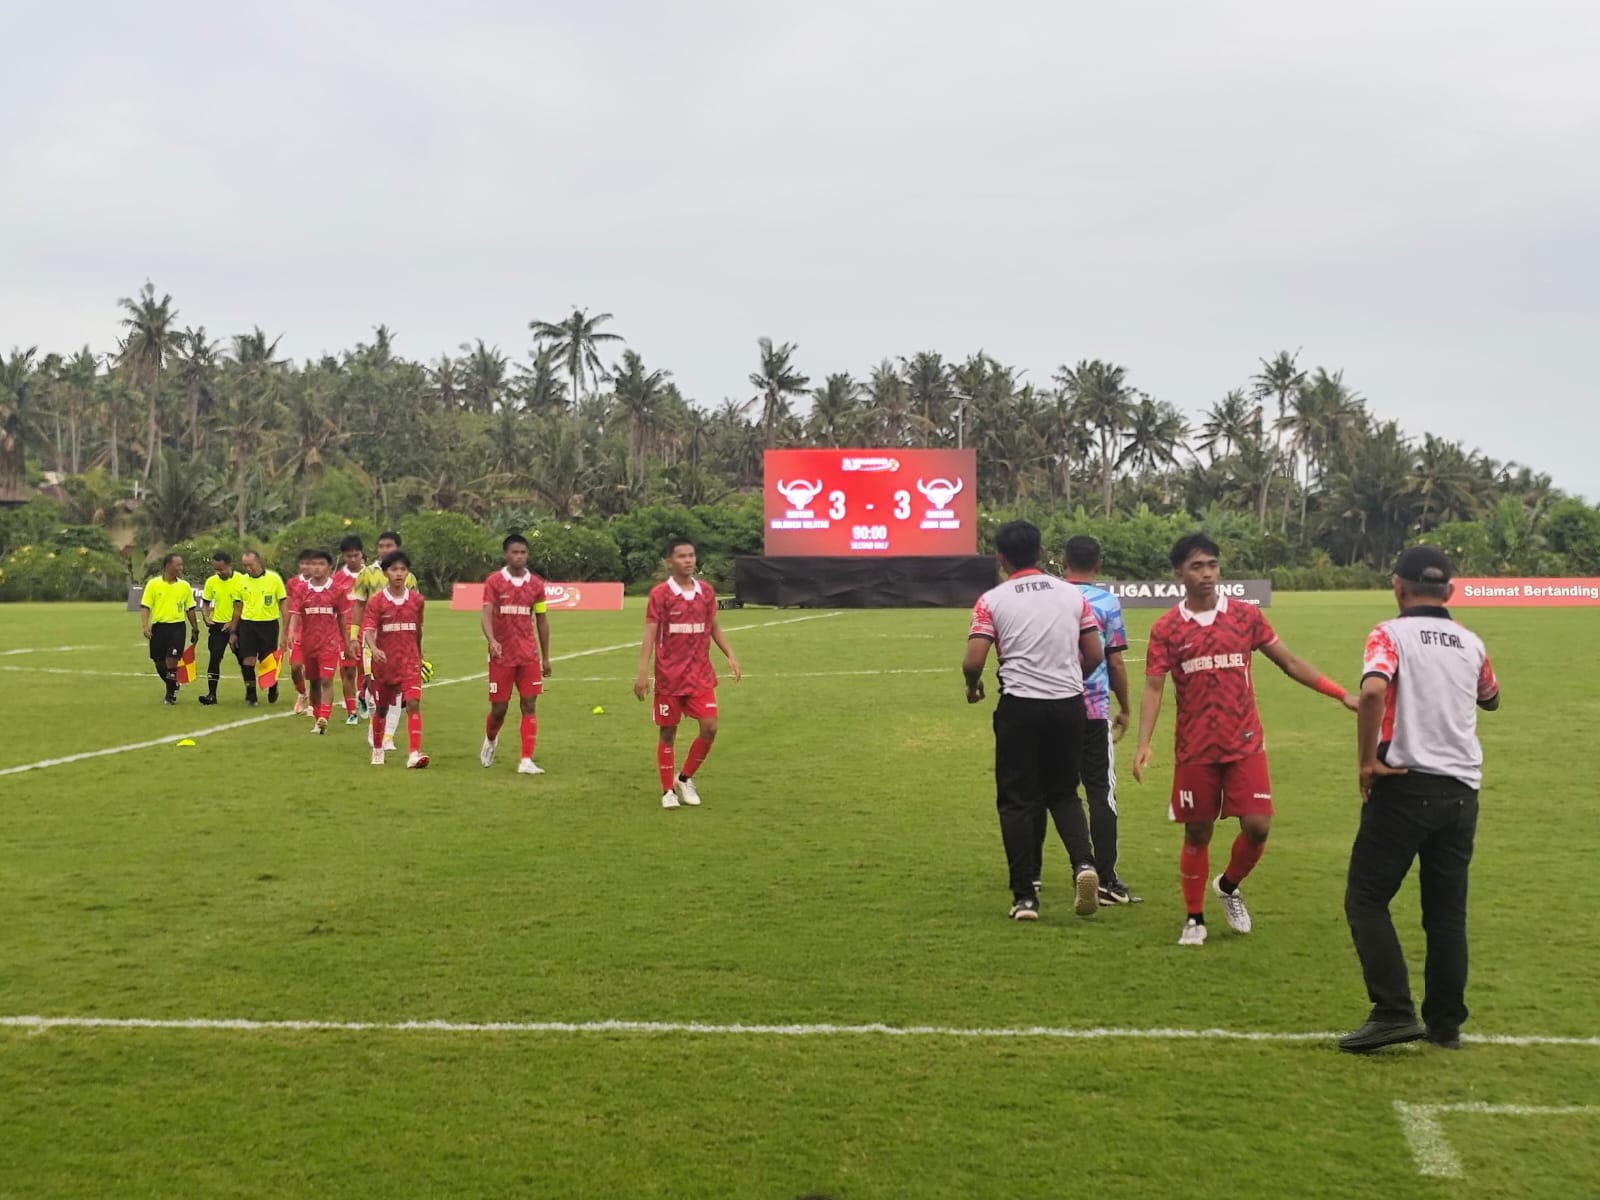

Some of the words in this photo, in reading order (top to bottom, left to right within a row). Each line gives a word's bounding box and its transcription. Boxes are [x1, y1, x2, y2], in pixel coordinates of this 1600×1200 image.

[829, 490, 846, 520] 3
[893, 490, 911, 520] 3
[853, 526, 887, 540] 90:00
[1014, 581, 1054, 594] OFFICIAL
[1109, 583, 1152, 597] LIGA
[1154, 583, 1245, 597] KANG
[1464, 585, 1520, 597] Selamat
[1523, 585, 1599, 599] Bertanding
[1420, 630, 1465, 649] OFFICIAL
[1214, 652, 1245, 669] SULSEL
[659, 704, 669, 717] 12
[1179, 790, 1194, 809] 14
